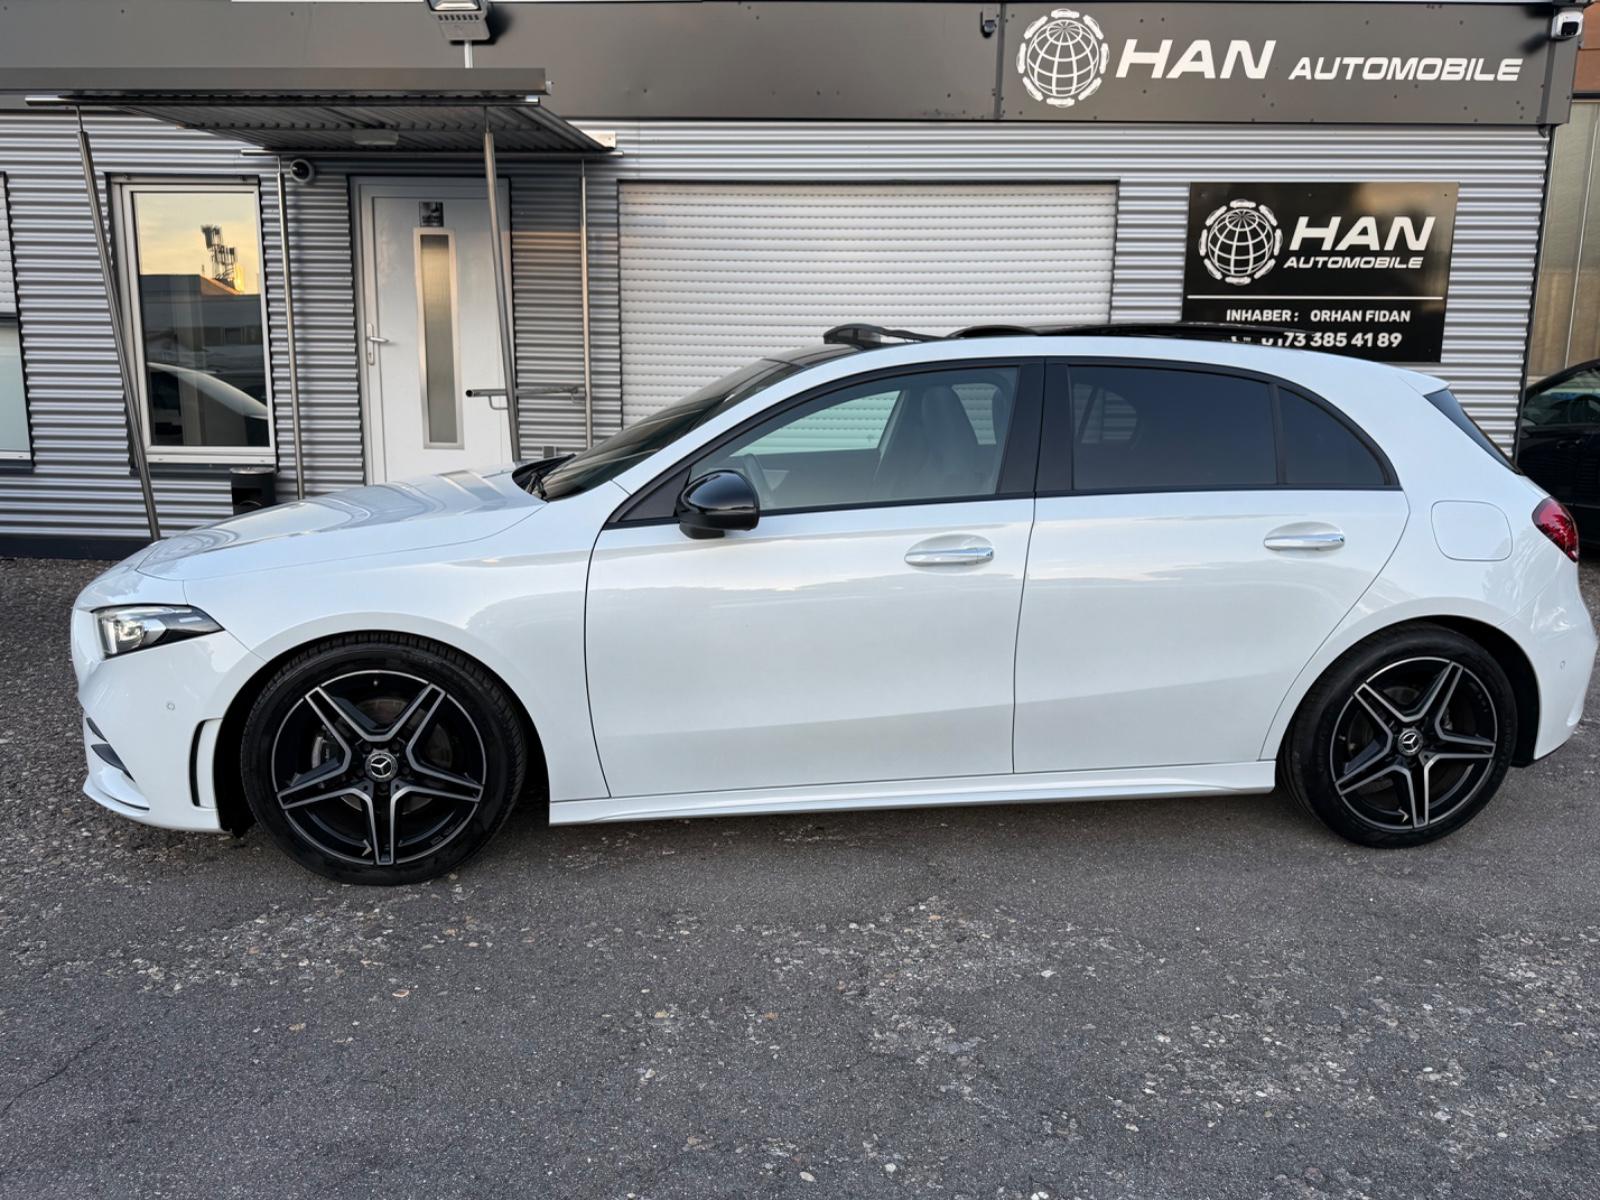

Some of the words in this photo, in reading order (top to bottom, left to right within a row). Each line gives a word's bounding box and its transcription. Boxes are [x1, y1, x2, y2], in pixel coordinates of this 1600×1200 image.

[1115, 38, 1277, 80] HAN
[1287, 56, 1523, 82] AUTOMOBILE
[1288, 216, 1436, 251] HAN
[1283, 256, 1424, 269] AUTOMOBILE
[1310, 309, 1362, 322] ORHAN
[1365, 310, 1411, 322] FIDAN
[1310, 332, 1348, 347] 385
